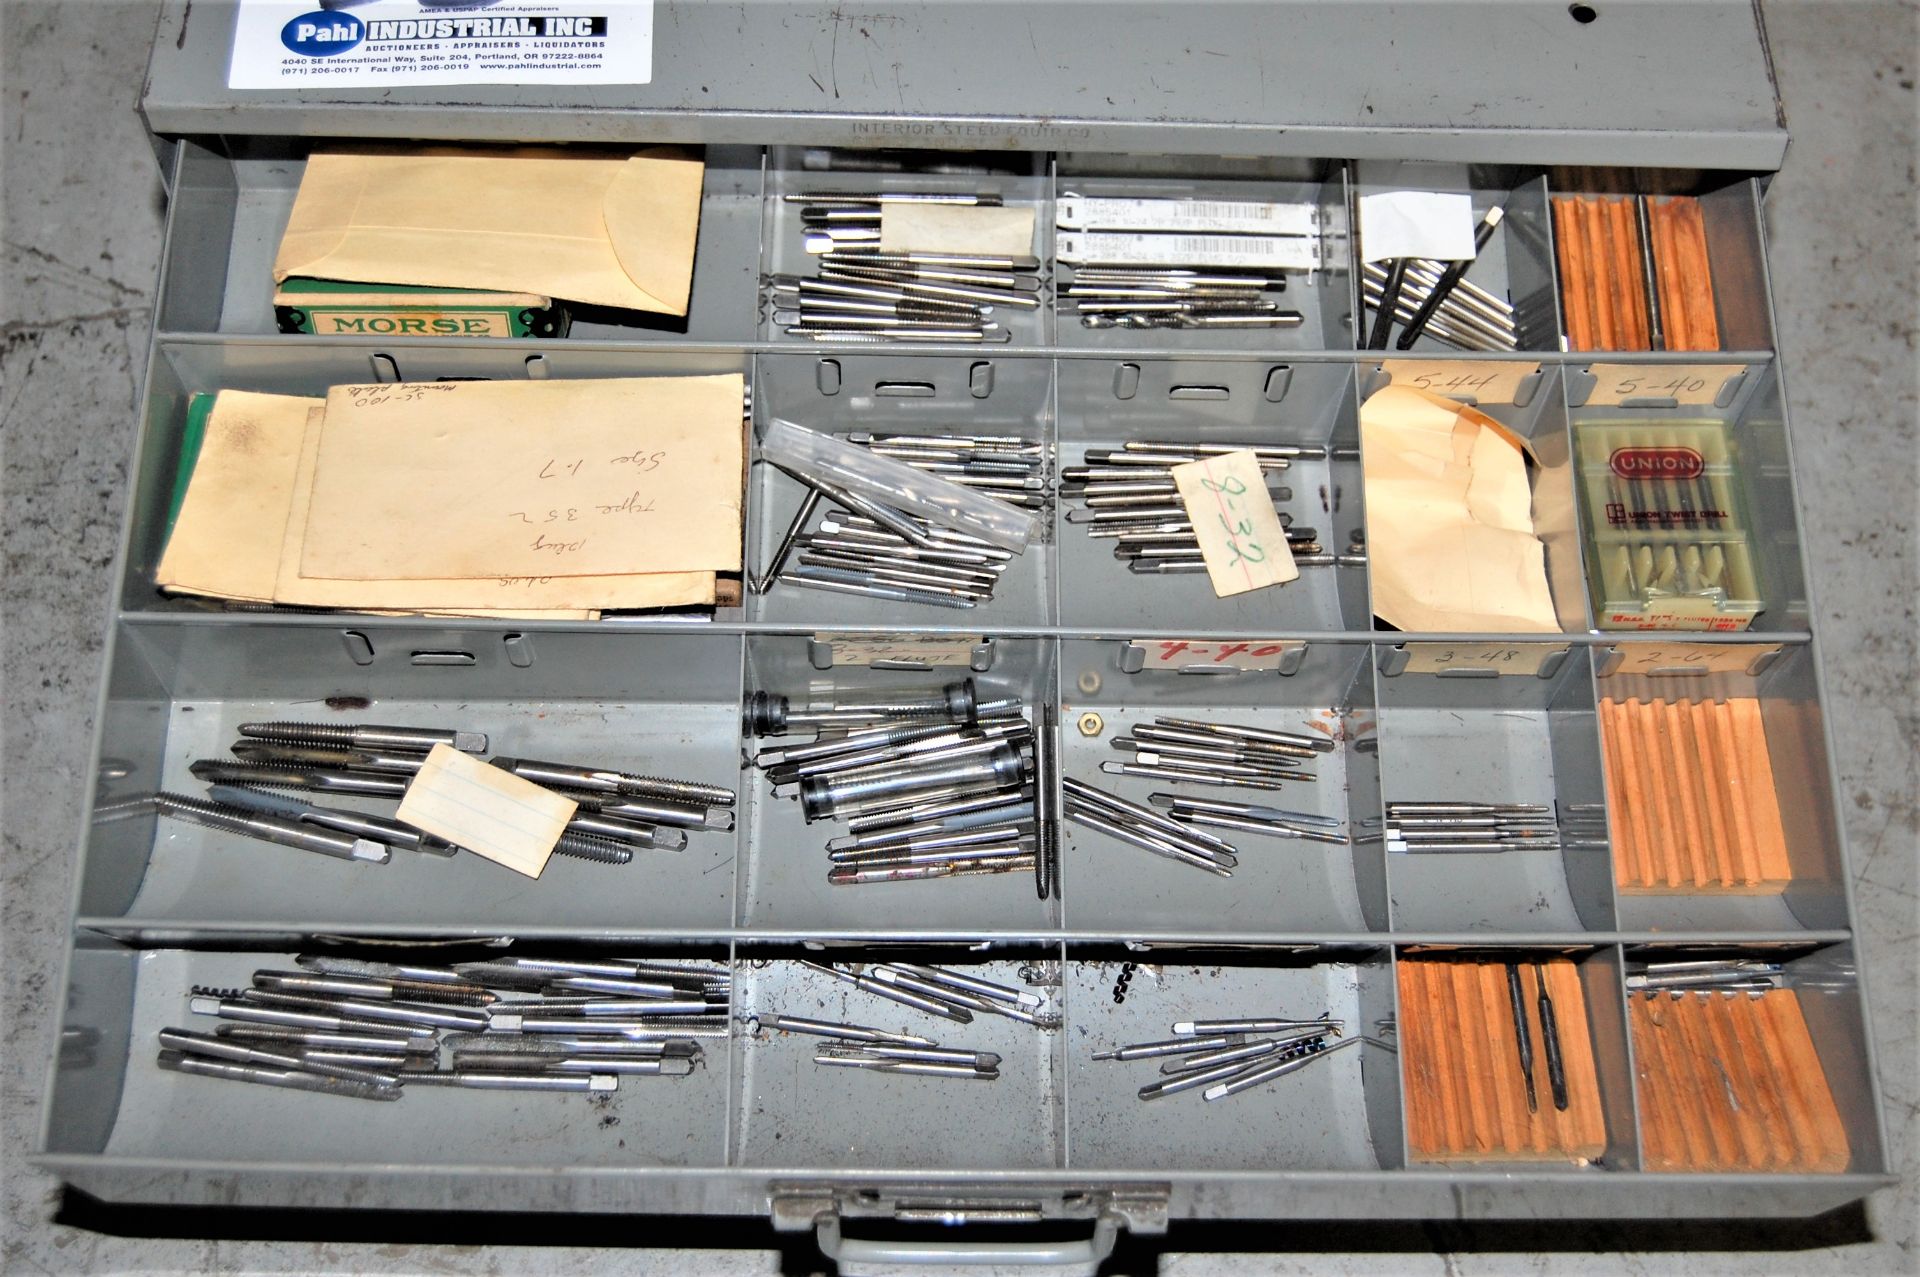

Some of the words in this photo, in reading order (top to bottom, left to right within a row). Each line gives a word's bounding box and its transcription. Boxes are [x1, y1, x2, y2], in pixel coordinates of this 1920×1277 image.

[297, 23, 358, 42] Pahl
[368, 18, 537, 40] INDUSTRIAL
[545, 17, 593, 37] INC
[365, 43, 440, 52] AUCTIONEERS
[328, 55, 391, 64] International
[450, 54, 472, 62] 204,
[475, 53, 521, 61] Portland,
[281, 66, 308, 76] (971)
[311, 66, 360, 74] 206-0017
[371, 65, 389, 73] Fax
[392, 65, 417, 73] (971)
[480, 62, 602, 70] www.pahlindustrial.com
[852, 122, 935, 136] INTERIOR
[333, 318, 491, 333] MORSE
[1413, 373, 1500, 391] 5-44
[1615, 378, 1705, 395] 5-40
[1621, 457, 1695, 470] UNION
[1201, 476, 1265, 567] 8-32
[1628, 510, 1661, 519] UNION
[1665, 510, 1696, 519] TWIST
[1699, 510, 1728, 519] DRILL
[1160, 642, 1282, 662] 4-40
[1435, 649, 1520, 663] 3-48
[1637, 650, 1730, 663] 2-64
